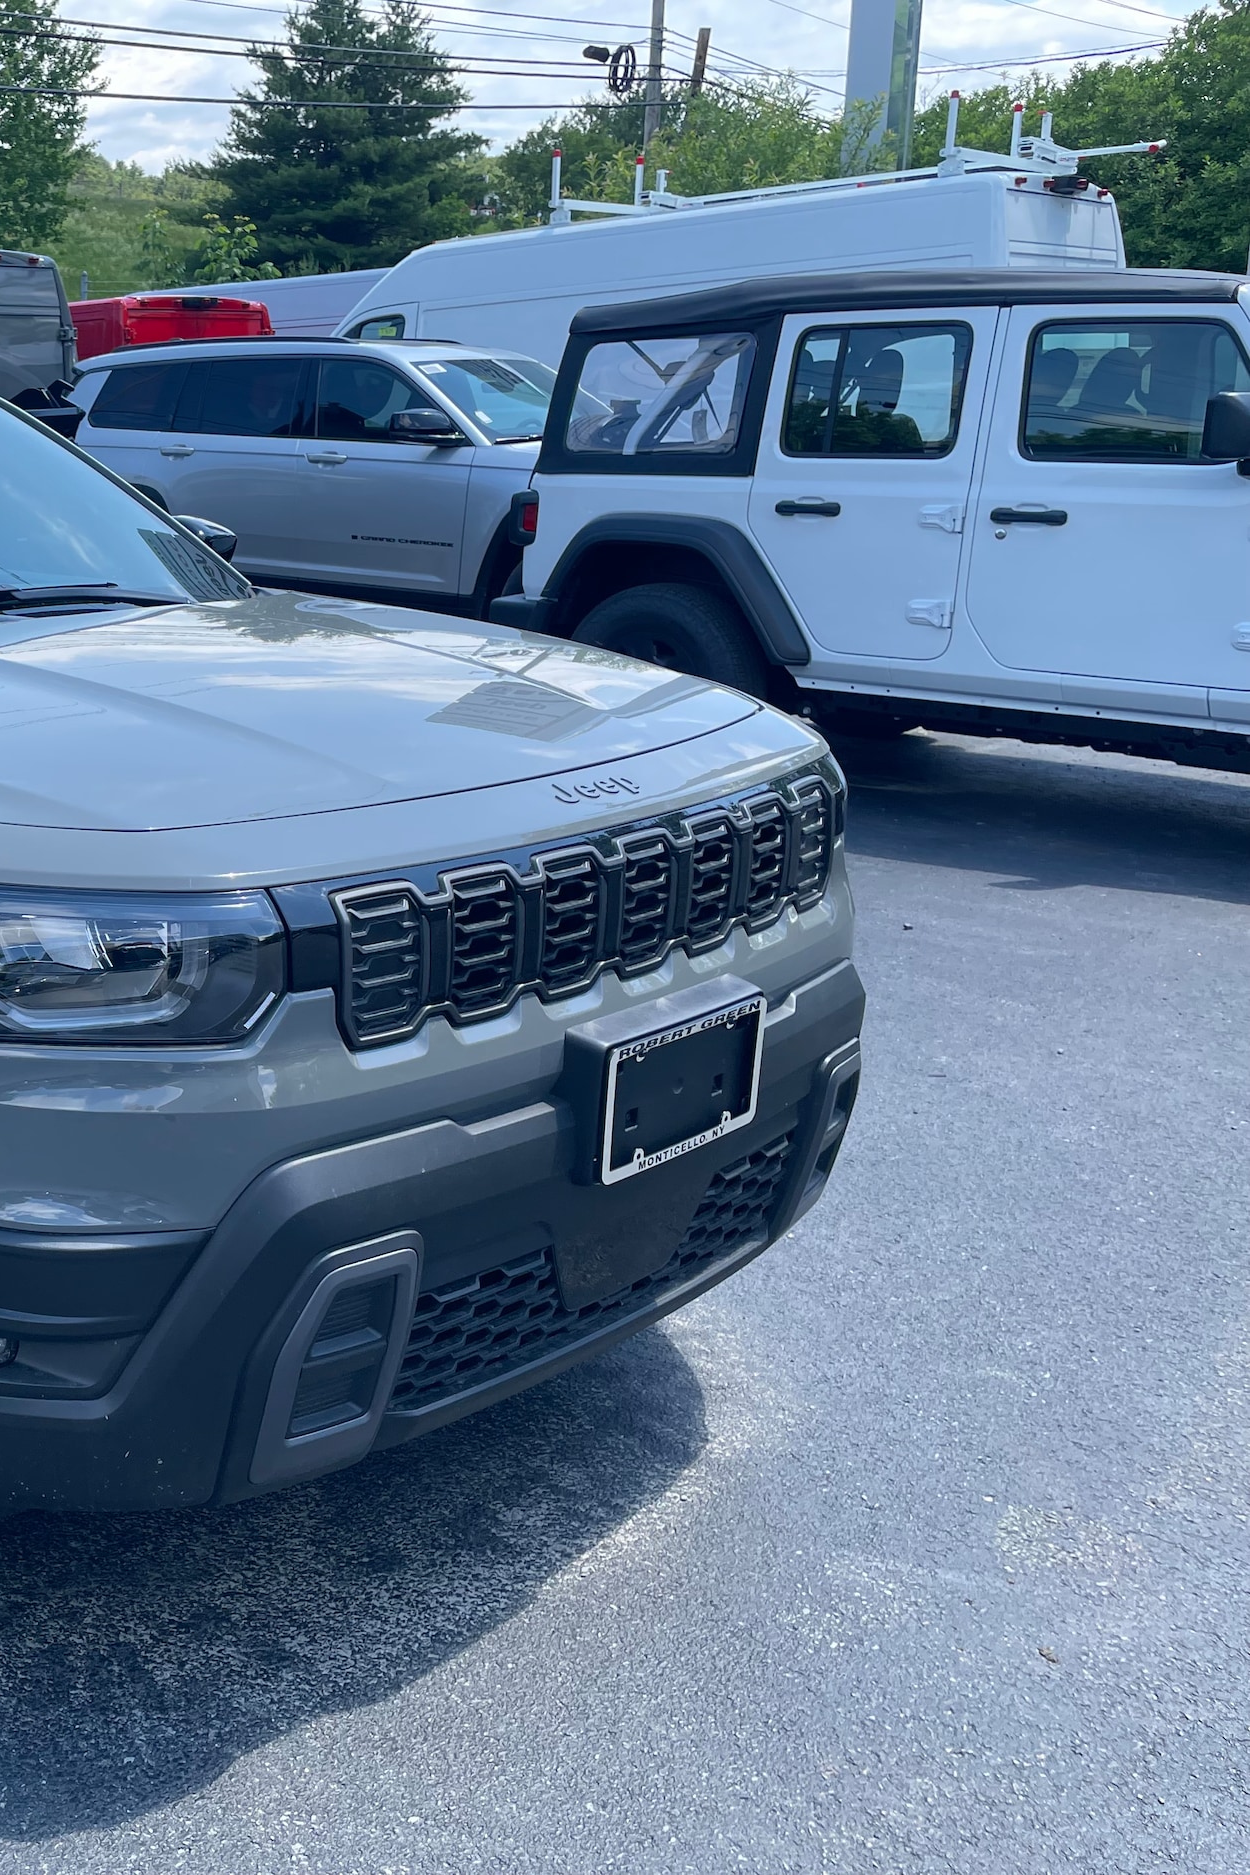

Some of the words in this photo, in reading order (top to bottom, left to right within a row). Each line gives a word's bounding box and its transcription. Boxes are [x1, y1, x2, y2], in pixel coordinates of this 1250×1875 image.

[360, 535, 395, 543] GRAND
[398, 538, 454, 548] CHEROKEE
[552, 777, 640, 803] Jeep
[619, 1024, 697, 1060] ROBERT
[701, 1000, 761, 1029] GREEN
[712, 1125, 725, 1139] NY
